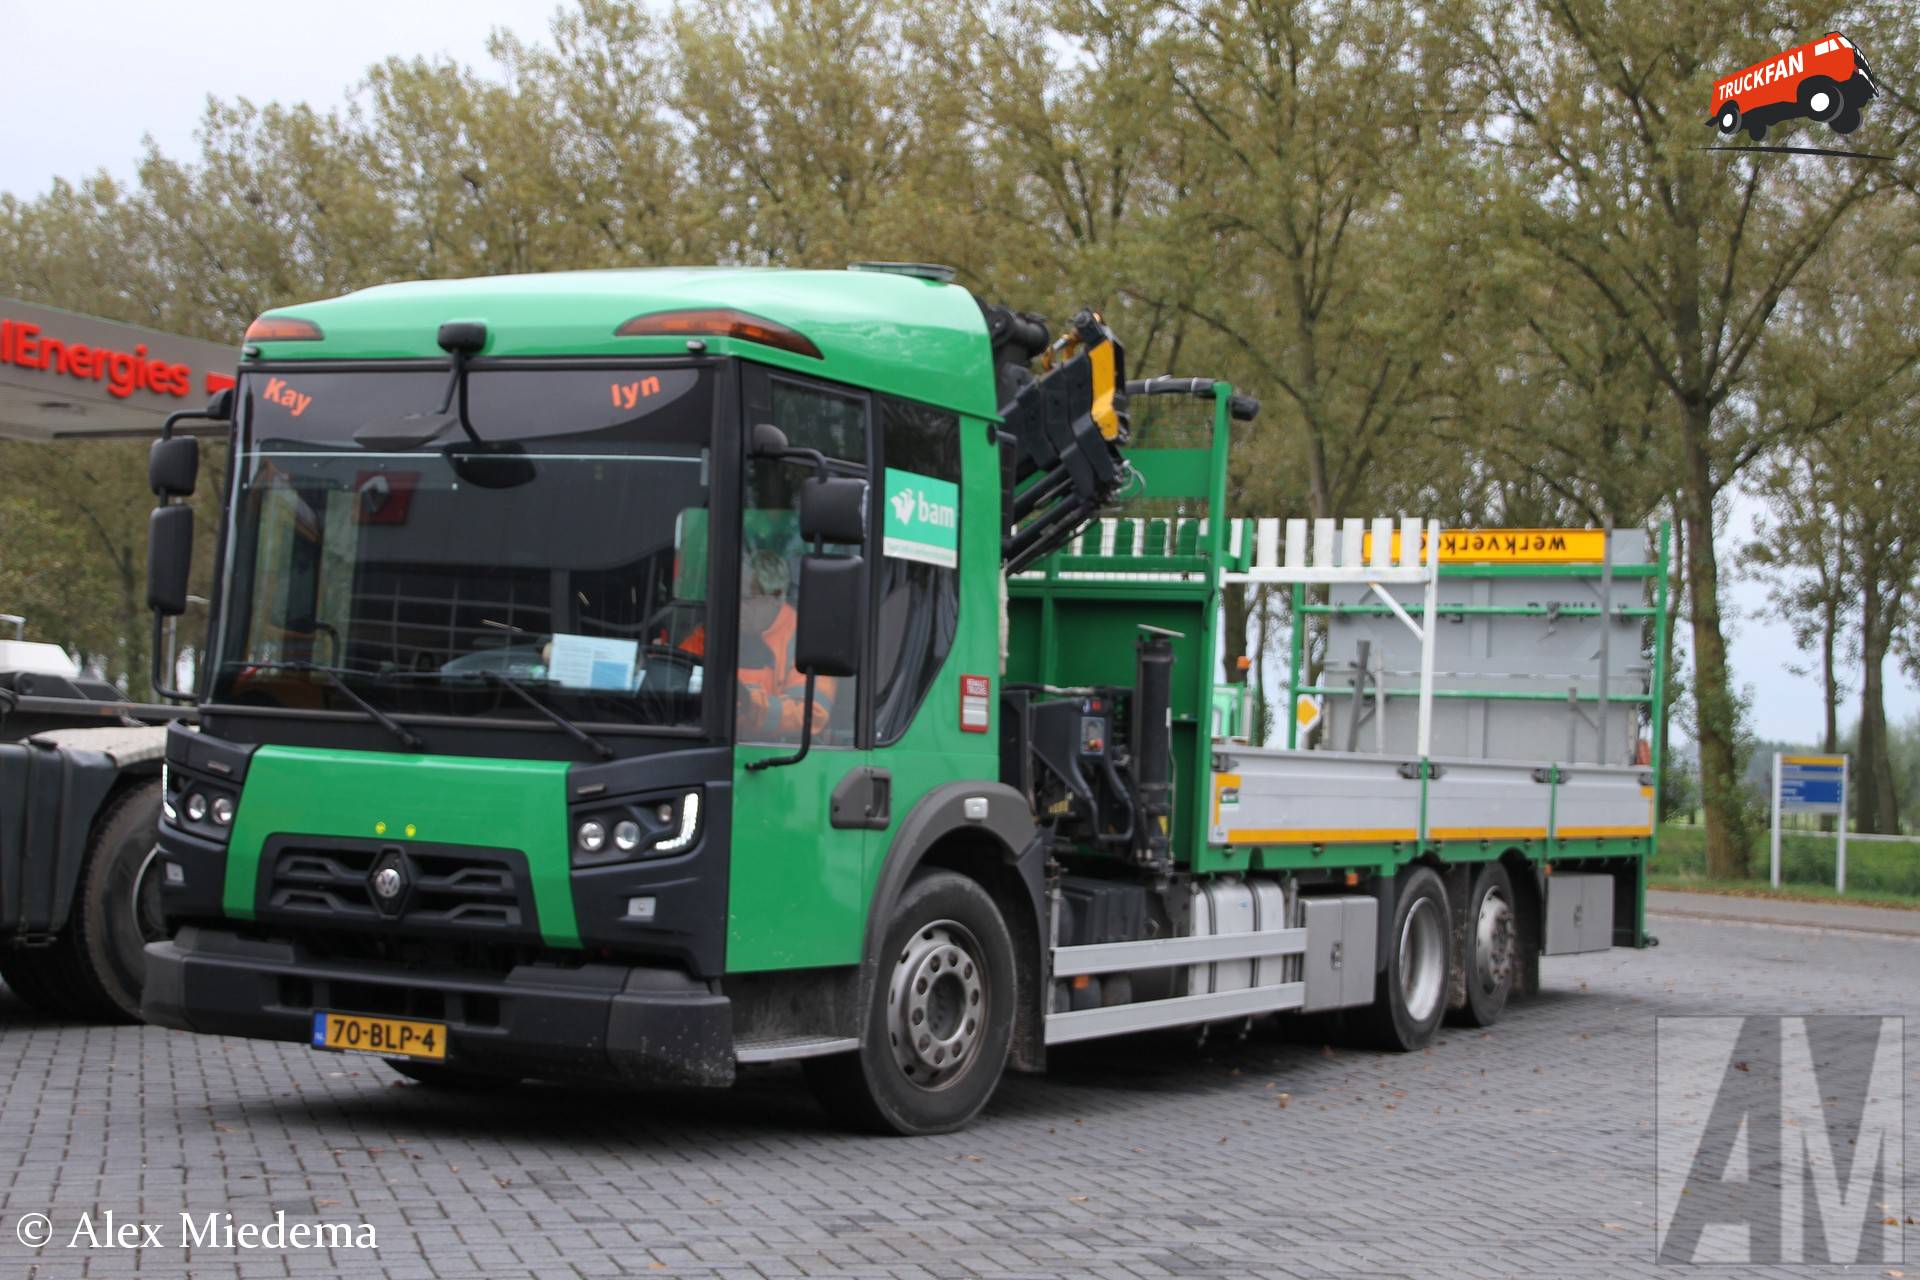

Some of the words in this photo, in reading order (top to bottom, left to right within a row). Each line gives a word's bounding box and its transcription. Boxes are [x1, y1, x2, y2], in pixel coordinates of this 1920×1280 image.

[263, 377, 312, 416] Kay
[917, 489, 955, 529] bam
[332, 1018, 436, 1052] 70-BLP-4
